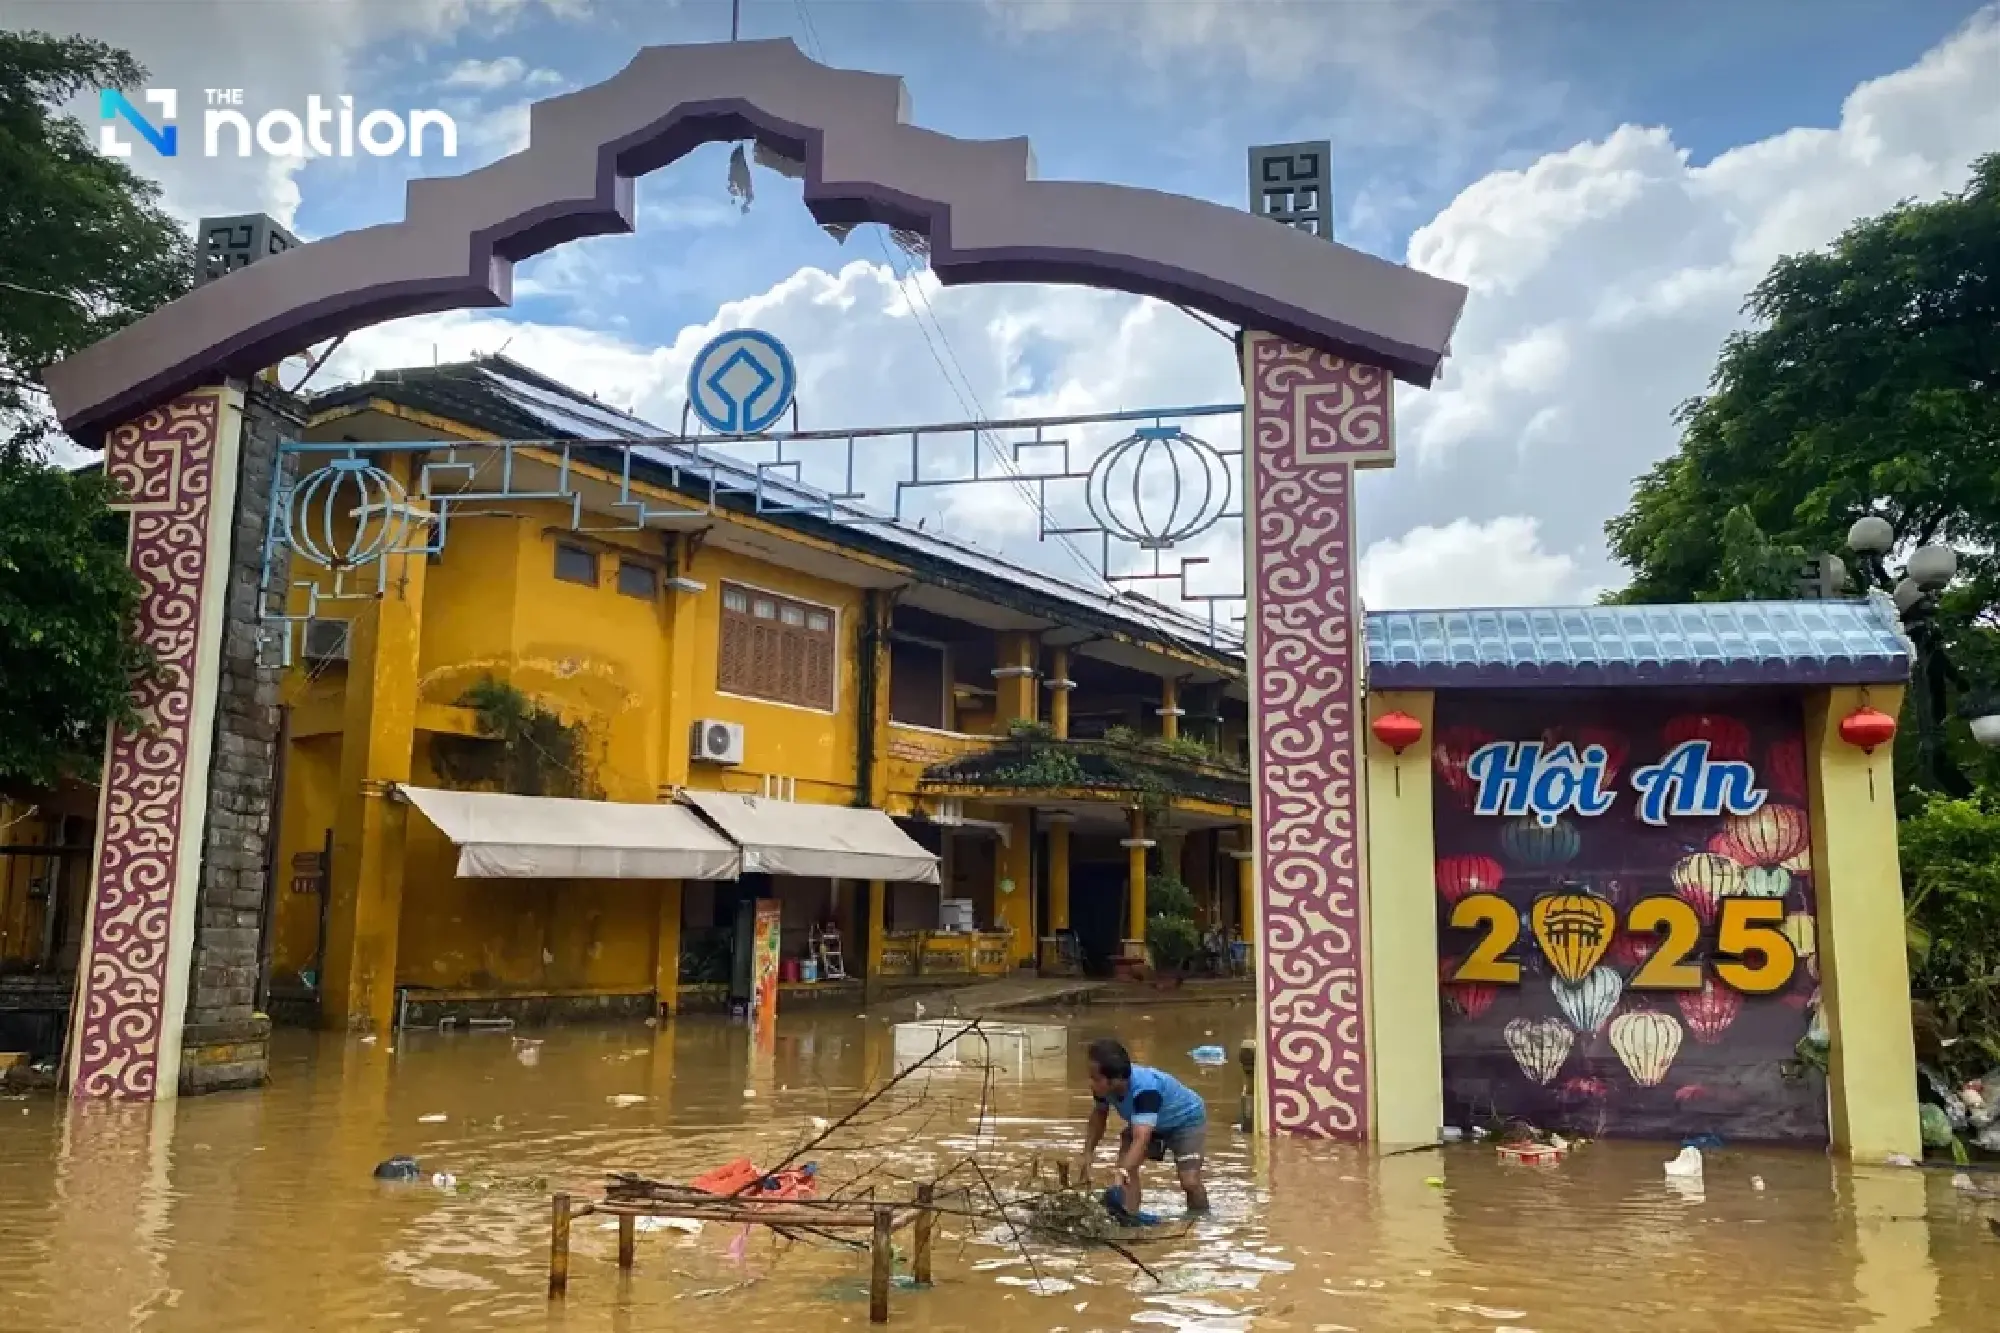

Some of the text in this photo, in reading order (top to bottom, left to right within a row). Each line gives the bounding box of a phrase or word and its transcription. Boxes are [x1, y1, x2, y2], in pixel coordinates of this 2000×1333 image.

[1467, 740, 1769, 828] Hội An
[1449, 892, 1797, 993] 2025
